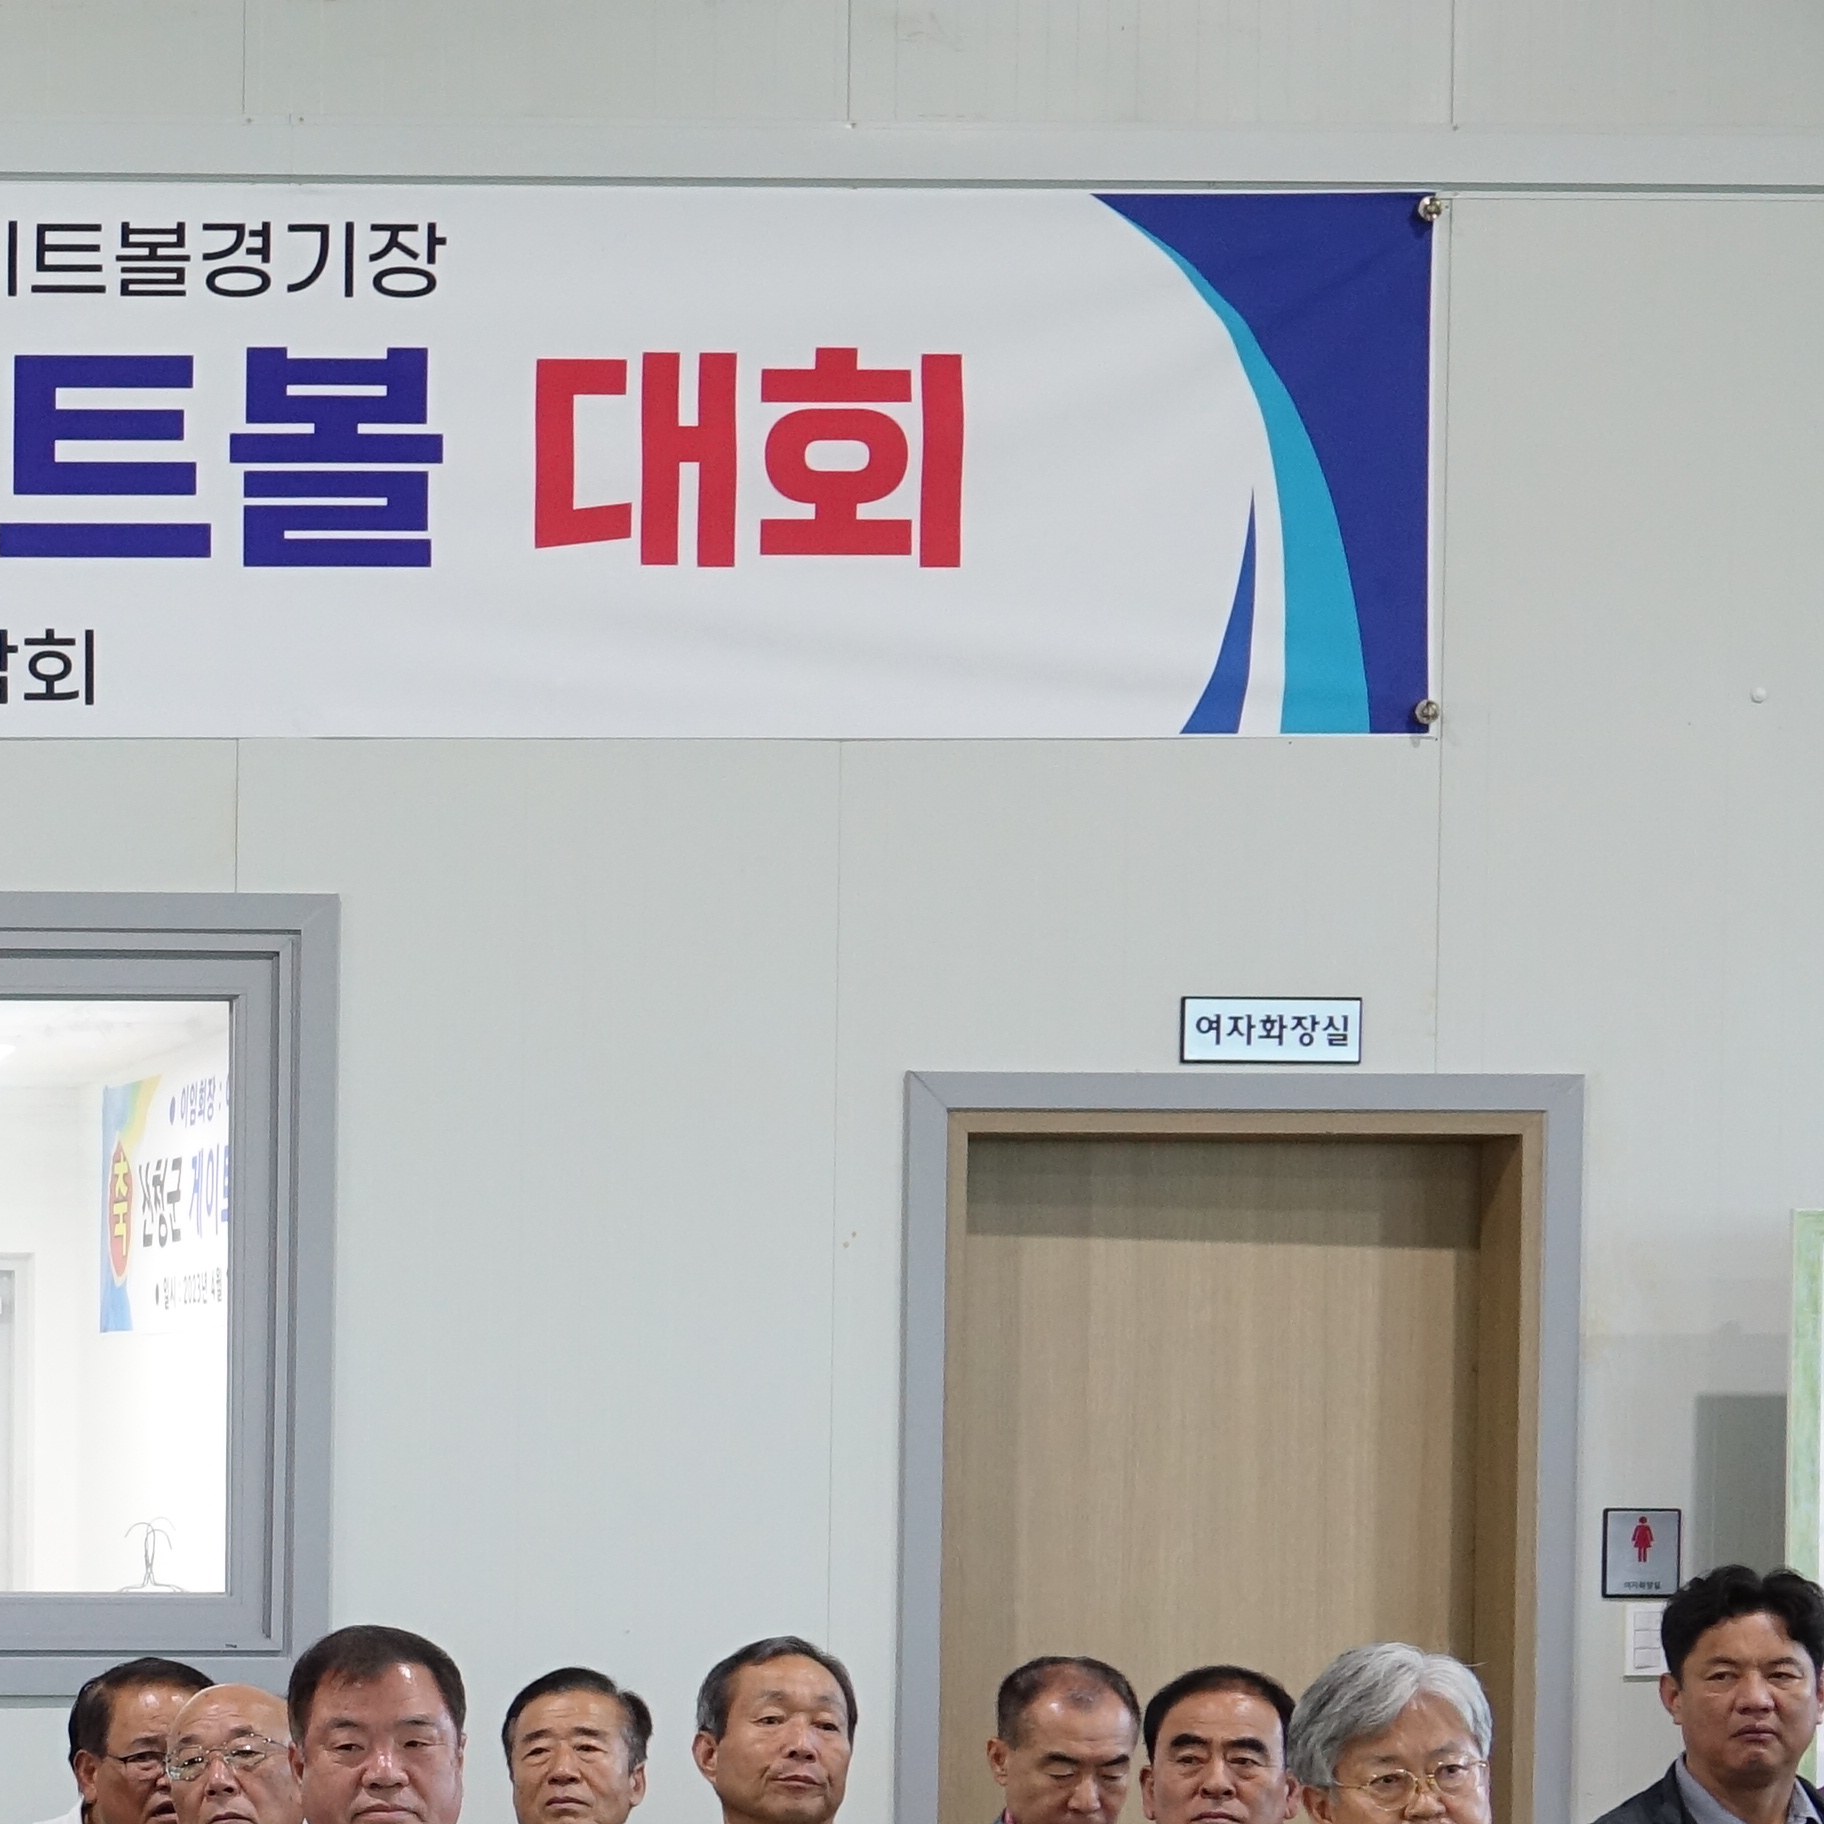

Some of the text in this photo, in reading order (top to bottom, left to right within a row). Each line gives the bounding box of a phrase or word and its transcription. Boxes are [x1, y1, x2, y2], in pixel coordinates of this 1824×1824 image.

[534, 347, 965, 568] 대회
[1195, 1013, 1351, 1047] 여자화장실
[113, 1151, 129, 1257] 축
[138, 1156, 183, 1248] 산청군
